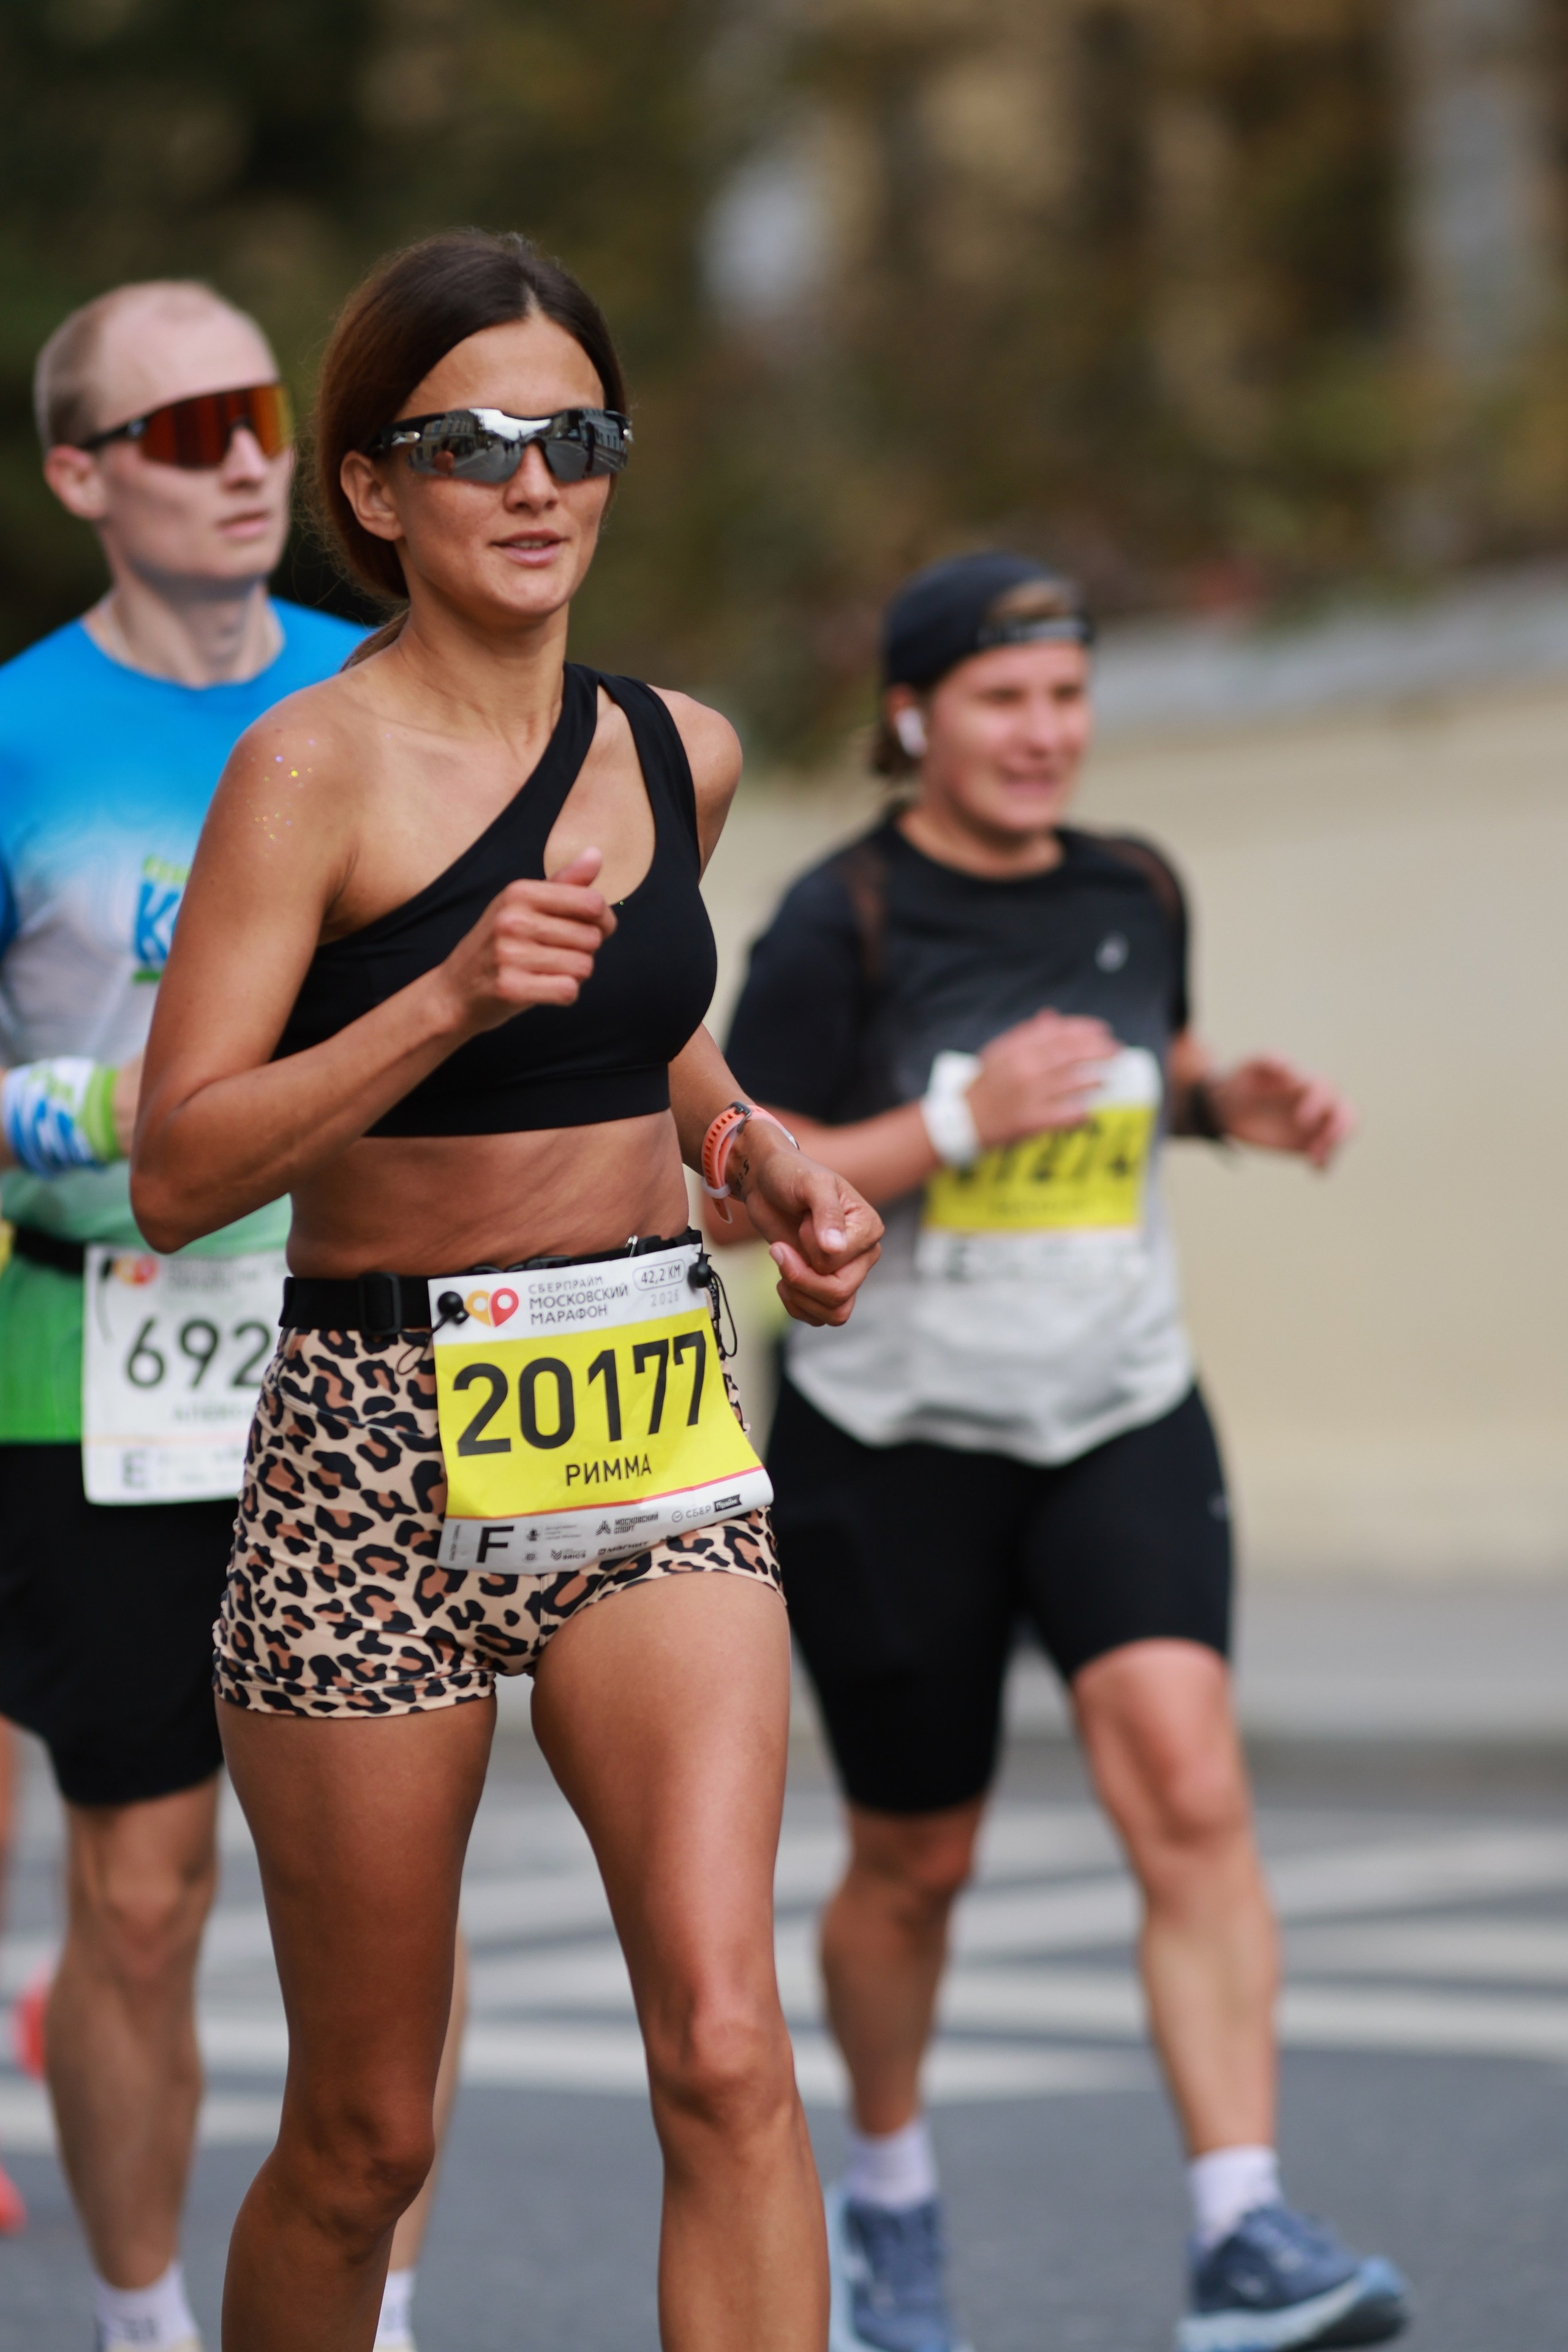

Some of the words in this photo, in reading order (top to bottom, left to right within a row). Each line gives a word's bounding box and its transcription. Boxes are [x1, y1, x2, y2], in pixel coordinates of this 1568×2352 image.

[528, 1275, 603, 1295] СБЕРПРАЙМ
[641, 1267, 665, 1284] 42,2
[529, 1283, 629, 1310] МОСКОВСКИЙ
[530, 1305, 608, 1325] МАРАФОН
[453, 1330, 707, 1457] 20177
[566, 1453, 652, 1486] РИММА
[614, 1512, 659, 1526] МОСКОВСКИЙ
[685, 1506, 711, 1518] СБЕР
[614, 1526, 635, 1534] СПОРТ
[476, 1526, 514, 1563] F
